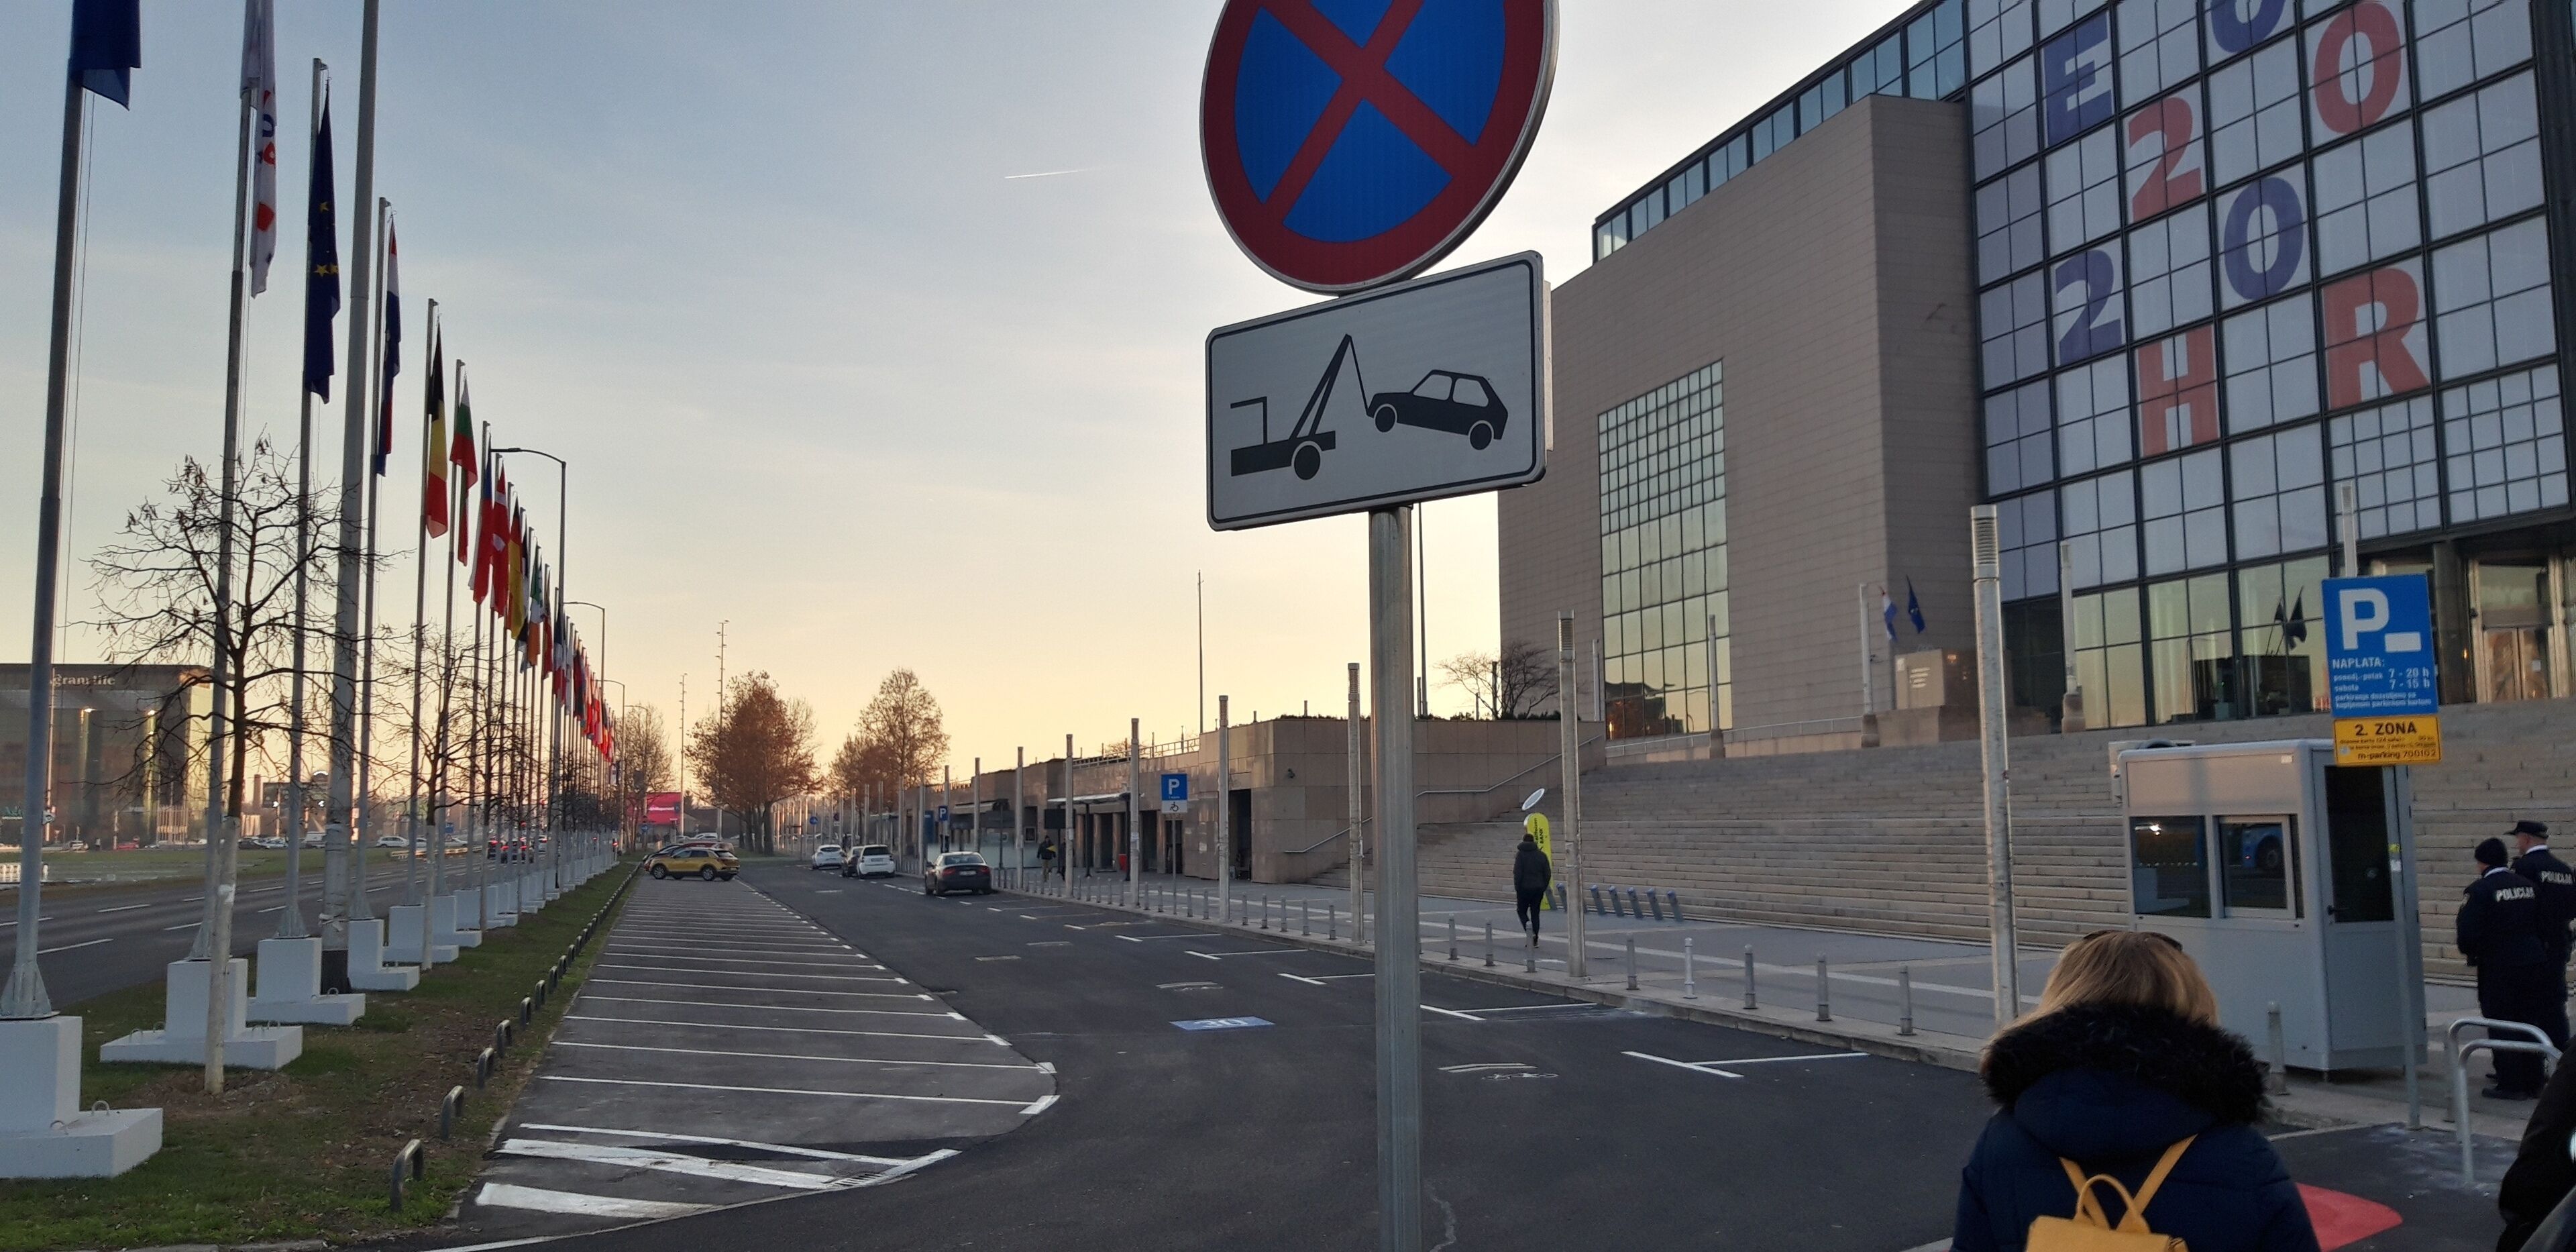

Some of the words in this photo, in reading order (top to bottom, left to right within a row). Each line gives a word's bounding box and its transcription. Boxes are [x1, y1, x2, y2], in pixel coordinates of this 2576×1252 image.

[2339, 588, 2390, 651] P
[2332, 657, 2385, 669] NAPLATA:
[2389, 668, 2396, 678] 7
[2406, 667, 2419, 678] 20
[2422, 666, 2429, 678] h
[2389, 679, 2396, 690] 7
[2406, 678, 2419, 688] 15
[2423, 678, 2430, 688] h
[2376, 721, 2417, 736] ZONA
[1169, 778, 1180, 795] P
[940, 808, 947, 819] P
[2496, 886, 2534, 902] POLICIJA
[1193, 1019, 1249, 1029] 30
